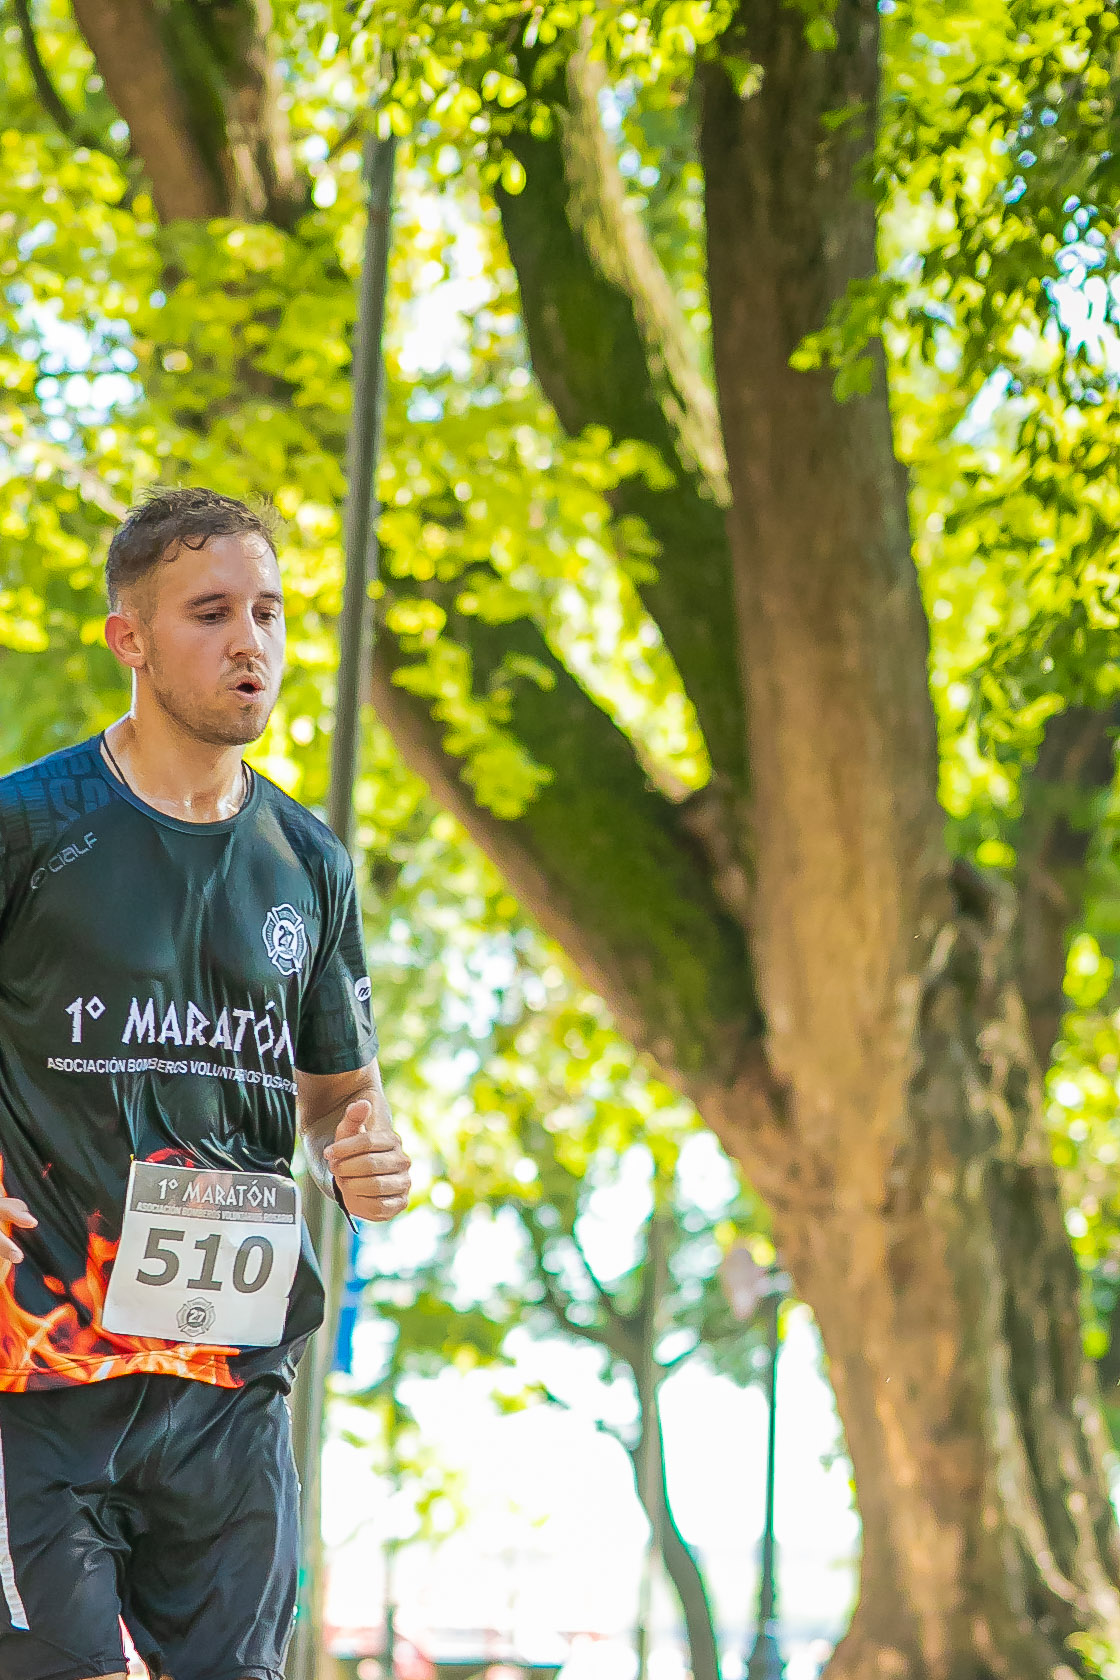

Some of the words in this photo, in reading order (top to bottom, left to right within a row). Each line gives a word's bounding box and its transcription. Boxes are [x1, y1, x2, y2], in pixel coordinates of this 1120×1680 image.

[47, 1057, 126, 1074] ASOCIACIÓN
[182, 1179, 277, 1208] MARATÓN
[136, 1227, 274, 1294] 510
